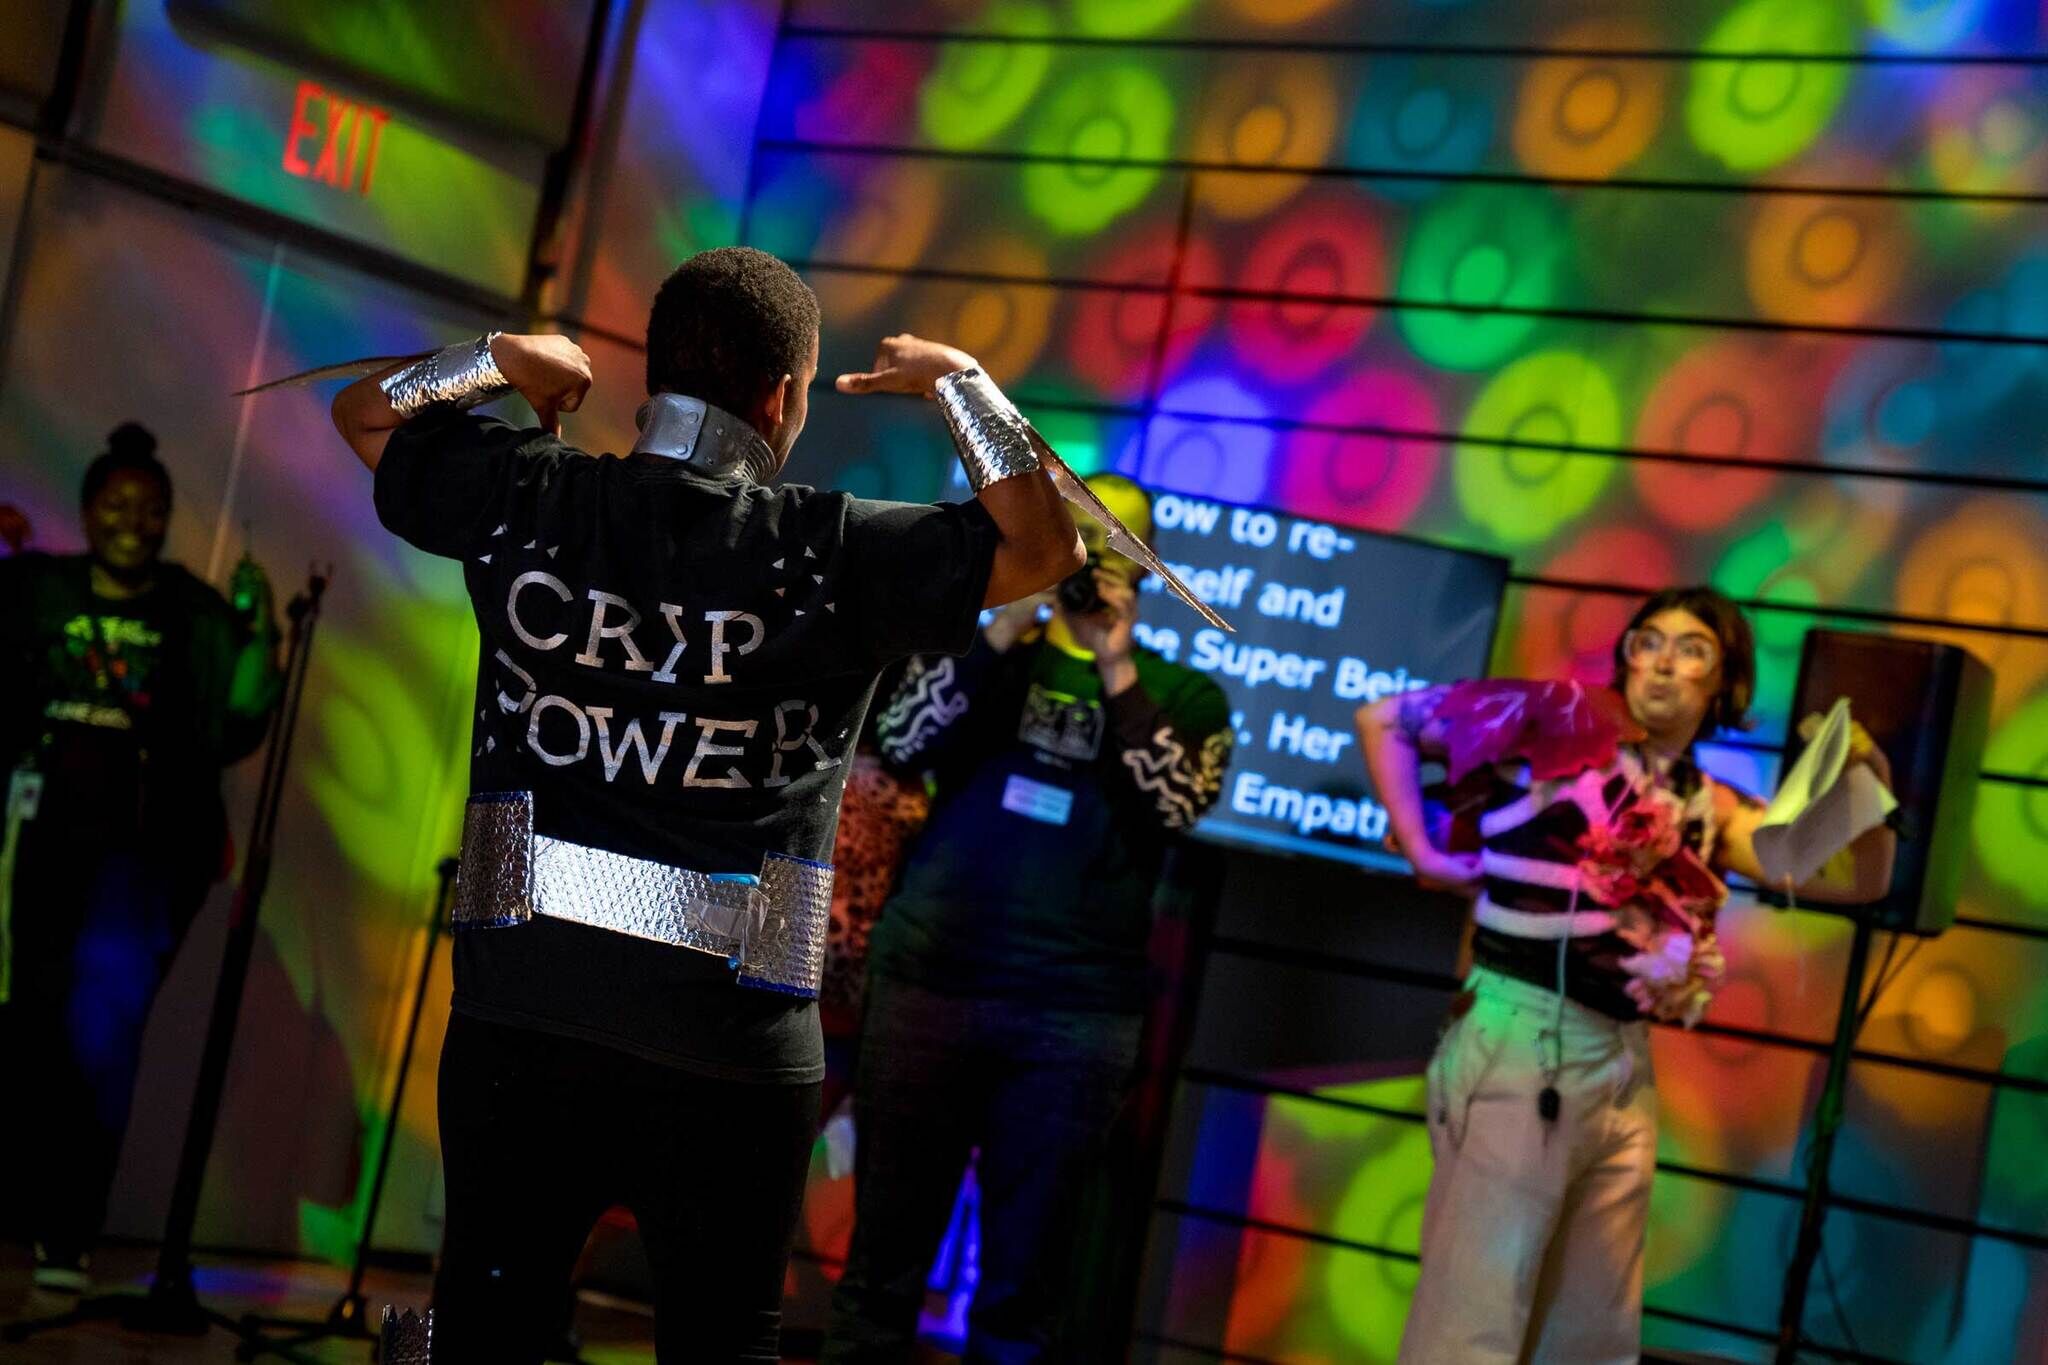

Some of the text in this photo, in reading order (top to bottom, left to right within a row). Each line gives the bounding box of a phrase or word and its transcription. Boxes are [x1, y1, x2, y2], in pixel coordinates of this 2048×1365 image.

[282, 80, 390, 198] EXIT
[1230, 509, 1278, 547] to
[1288, 521, 1355, 560] re-
[507, 571, 765, 684] CRIP
[1257, 582, 1345, 629] and
[1190, 628, 1328, 690] Super
[1268, 709, 1354, 764] Her
